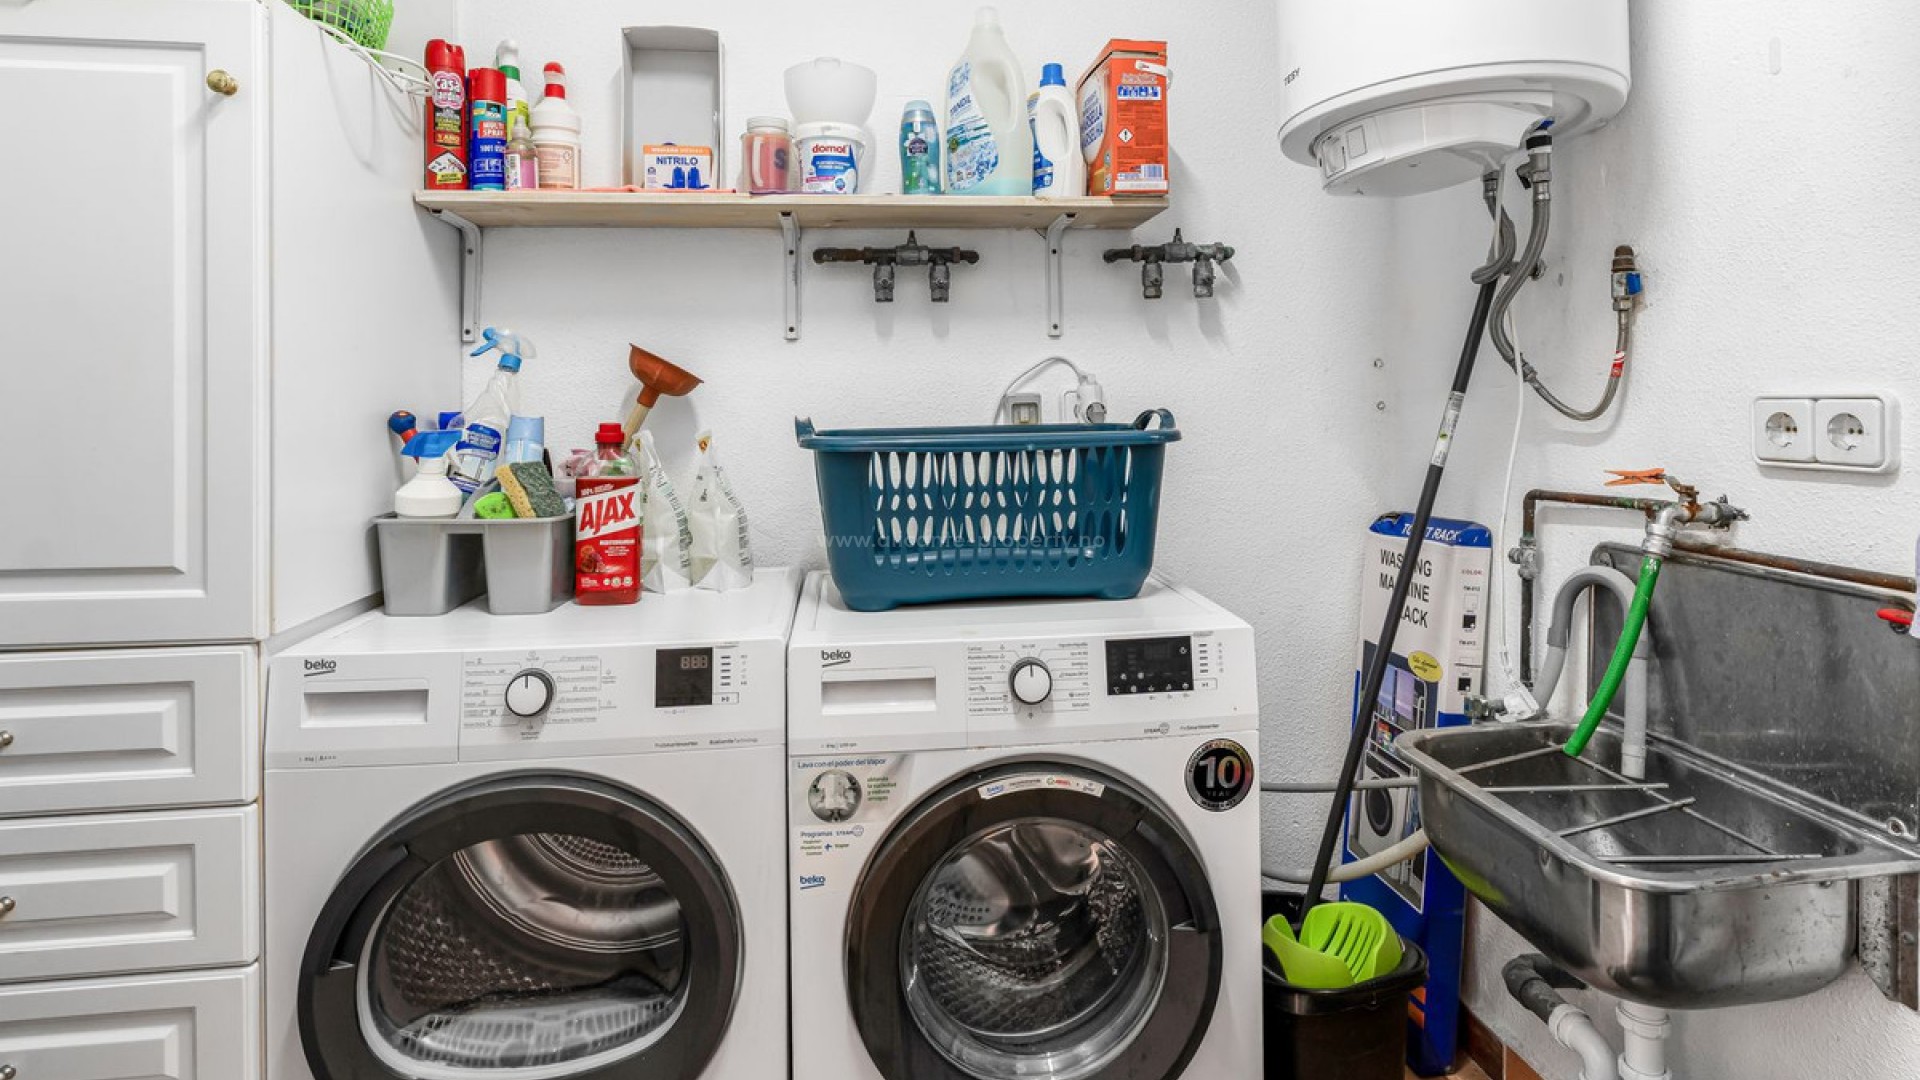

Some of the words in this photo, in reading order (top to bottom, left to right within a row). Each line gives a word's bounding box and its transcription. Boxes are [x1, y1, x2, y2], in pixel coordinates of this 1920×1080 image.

[812, 143, 848, 154] domol
[655, 155, 699, 166] NITRILO
[579, 491, 636, 535] AJAX
[1380, 548, 1433, 578] WASNG
[1379, 572, 1430, 603] MAINE
[1399, 605, 1429, 628] ACK
[821, 649, 851, 661] beko
[304, 659, 337, 670] beko
[798, 761, 813, 769] Lava
[834, 760, 854, 768] poder
[1198, 755, 1242, 789] 10
[799, 875, 826, 885] beko
